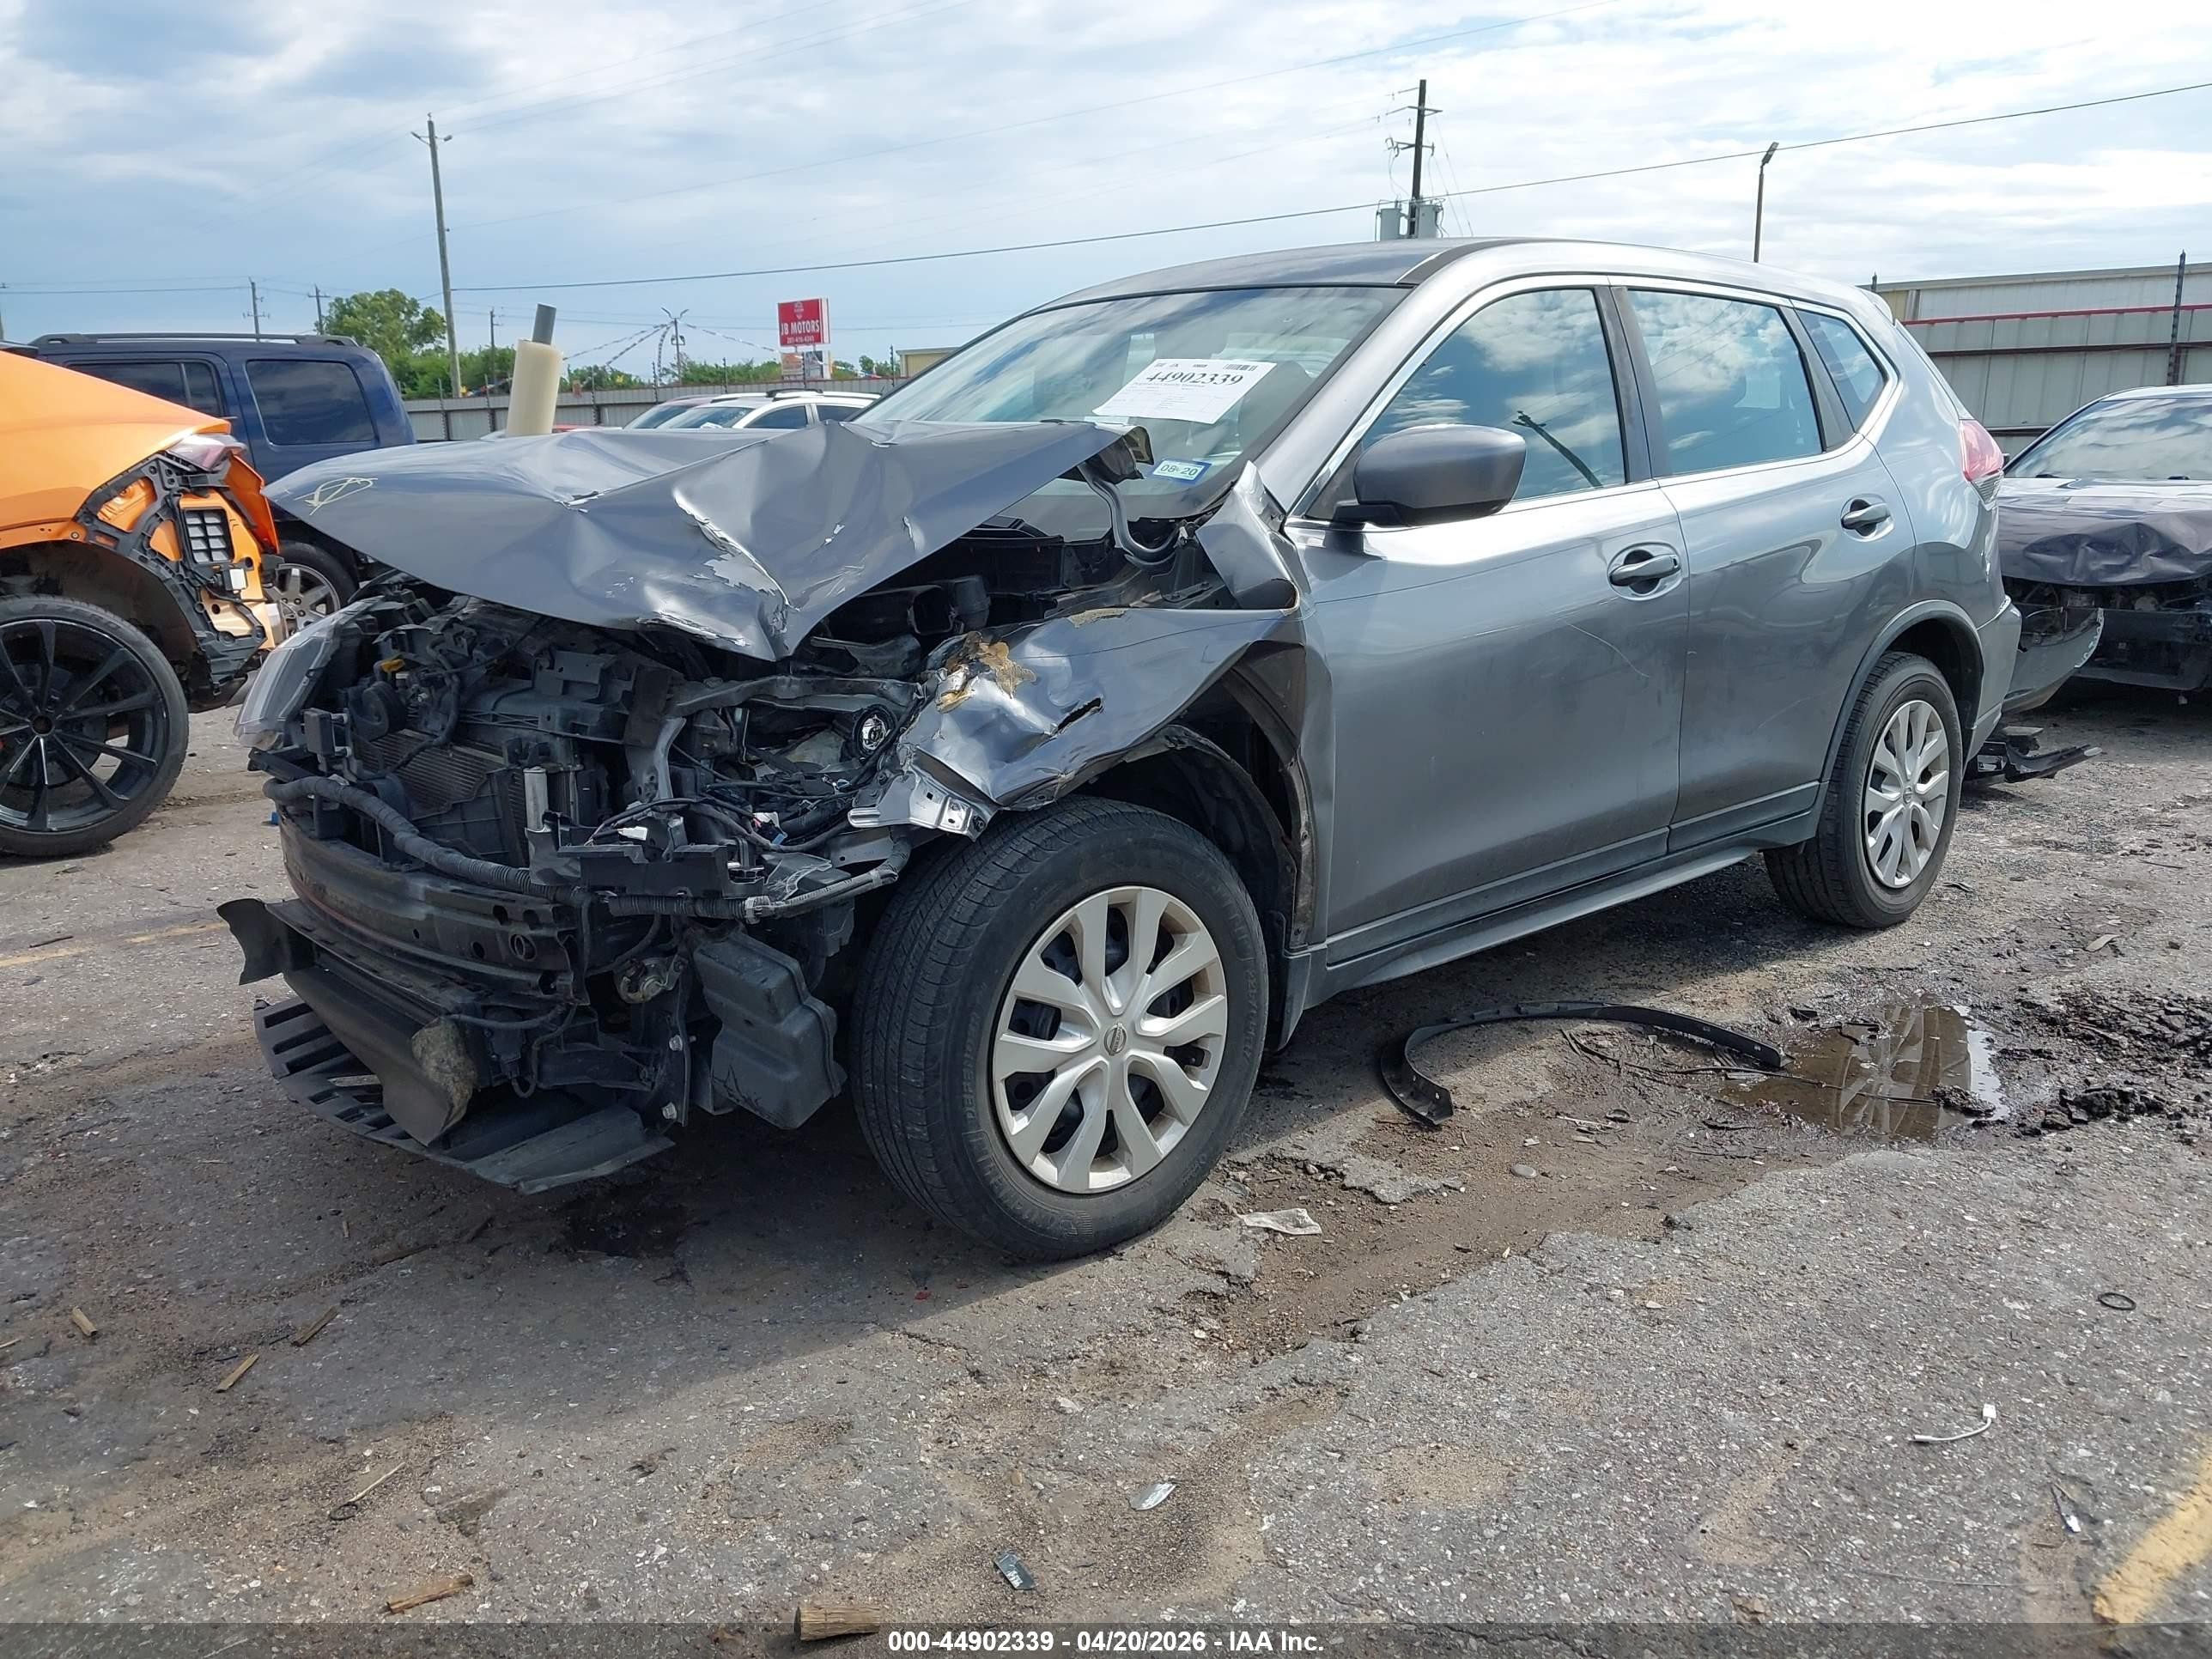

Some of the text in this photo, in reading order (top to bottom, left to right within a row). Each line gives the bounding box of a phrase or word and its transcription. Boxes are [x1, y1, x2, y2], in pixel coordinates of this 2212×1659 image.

[781, 319, 819, 336] JB MOTORS
[1146, 371, 1244, 386] 44902339
[1181, 467, 1198, 476] 20
